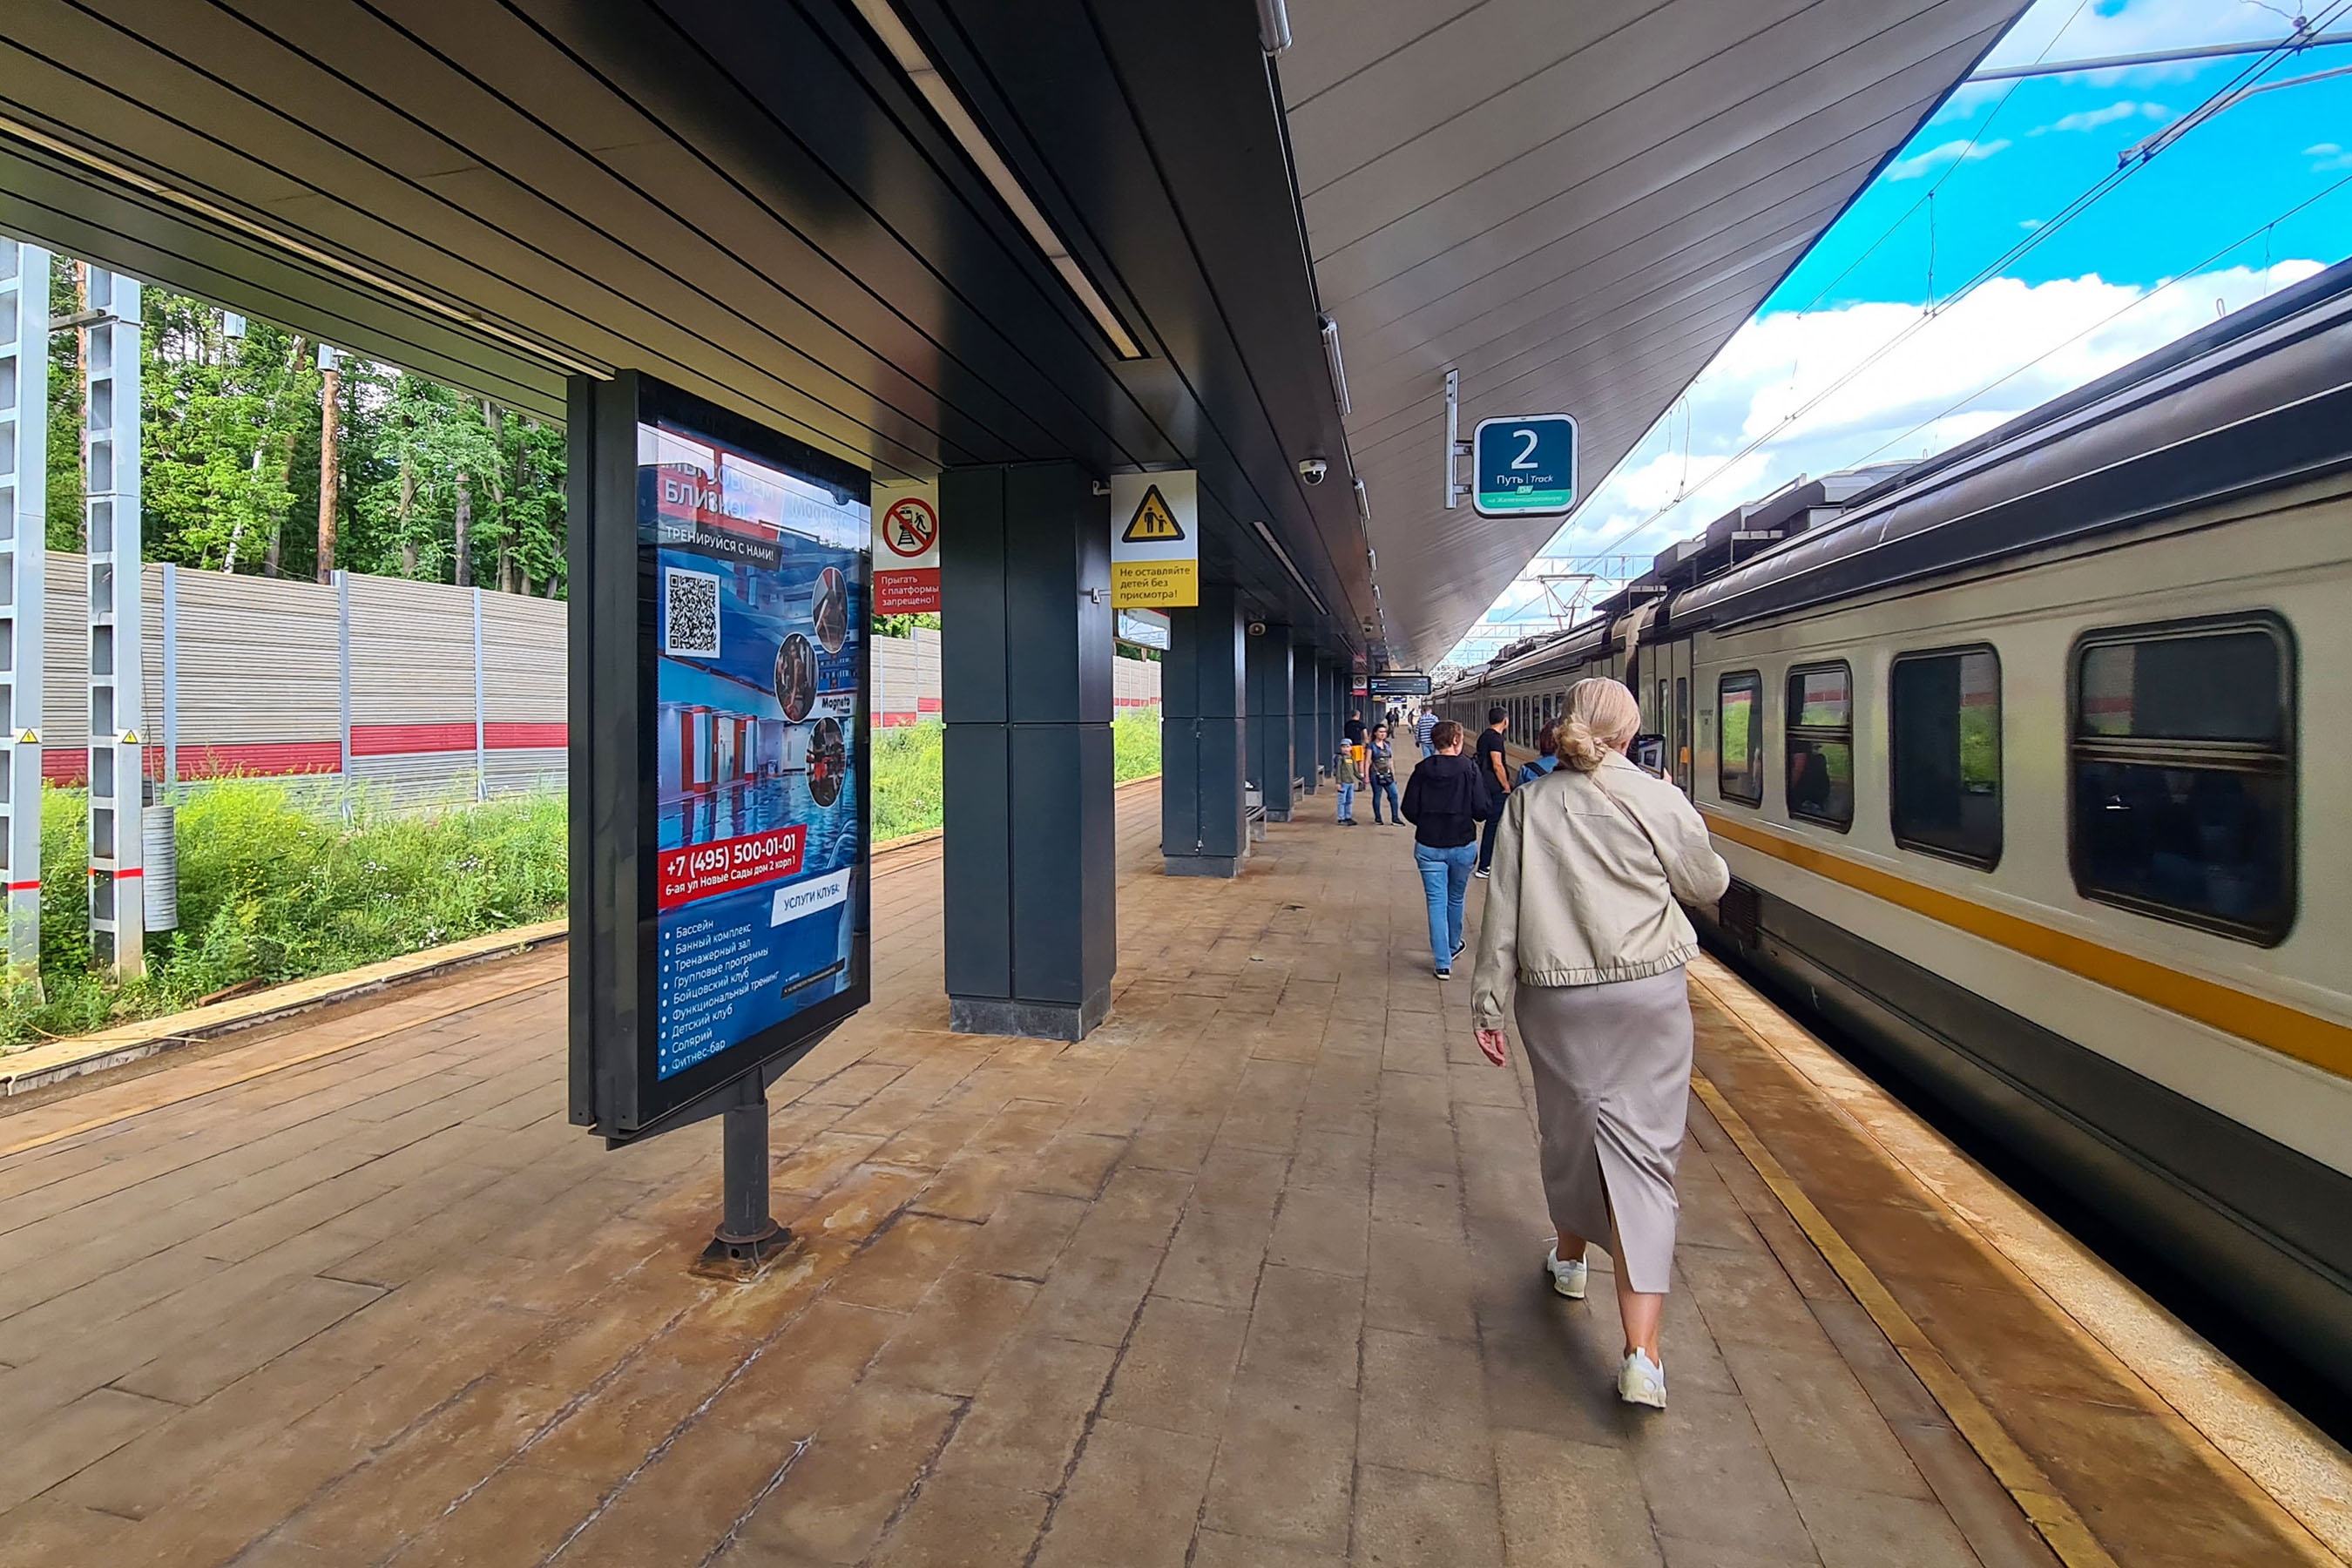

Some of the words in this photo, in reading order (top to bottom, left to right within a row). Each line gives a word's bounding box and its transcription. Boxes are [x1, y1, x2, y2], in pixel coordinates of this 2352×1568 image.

[1511, 429, 1539, 470] 2
[1497, 475, 1524, 487] Путь
[1531, 475, 1553, 483] Track
[666, 525, 736, 552] ТРЕНИРУЙСЯ
[738, 542, 745, 554] С
[747, 544, 774, 562] НАМИ!
[881, 576, 918, 586] Прыгать
[1120, 568, 1133, 577] Не
[1135, 566, 1191, 576] оставляйте
[1120, 578, 1149, 590] детей
[1151, 578, 1168, 587] без
[882, 596, 935, 607] запрещено!
[889, 585, 940, 596] платформы
[1120, 590, 1178, 601] присмотра!
[667, 856, 686, 877] +7
[690, 847, 730, 878] (495)
[733, 834, 796, 864] 500-01-01
[666, 881, 685, 896] 6-ая
[687, 881, 699, 893] ул
[700, 874, 728, 887] Новые
[731, 868, 753, 880] Сады
[754, 865, 768, 876] дом
[769, 862, 774, 871] 2
[774, 859, 792, 870] корп
[784, 891, 815, 911] УСЛУГИ
[675, 935, 712, 956] Банный
[713, 923, 752, 943] комплекс
[676, 919, 714, 939] Бассейн
[673, 964, 724, 989] Групповые
[725, 947, 769, 970] программы
[674, 942, 737, 972] Тренажерный
[738, 939, 751, 951] зал
[672, 983, 749, 1021] Функциональный
[750, 970, 781, 990] тренинг
[673, 976, 729, 1004] Бойцовский
[730, 967, 750, 983] клуб
[672, 1013, 711, 1040] Детский
[712, 1003, 733, 1021] клуб
[672, 1027, 713, 1054] Солярий
[672, 1038, 726, 1070] Фитнес-бар
